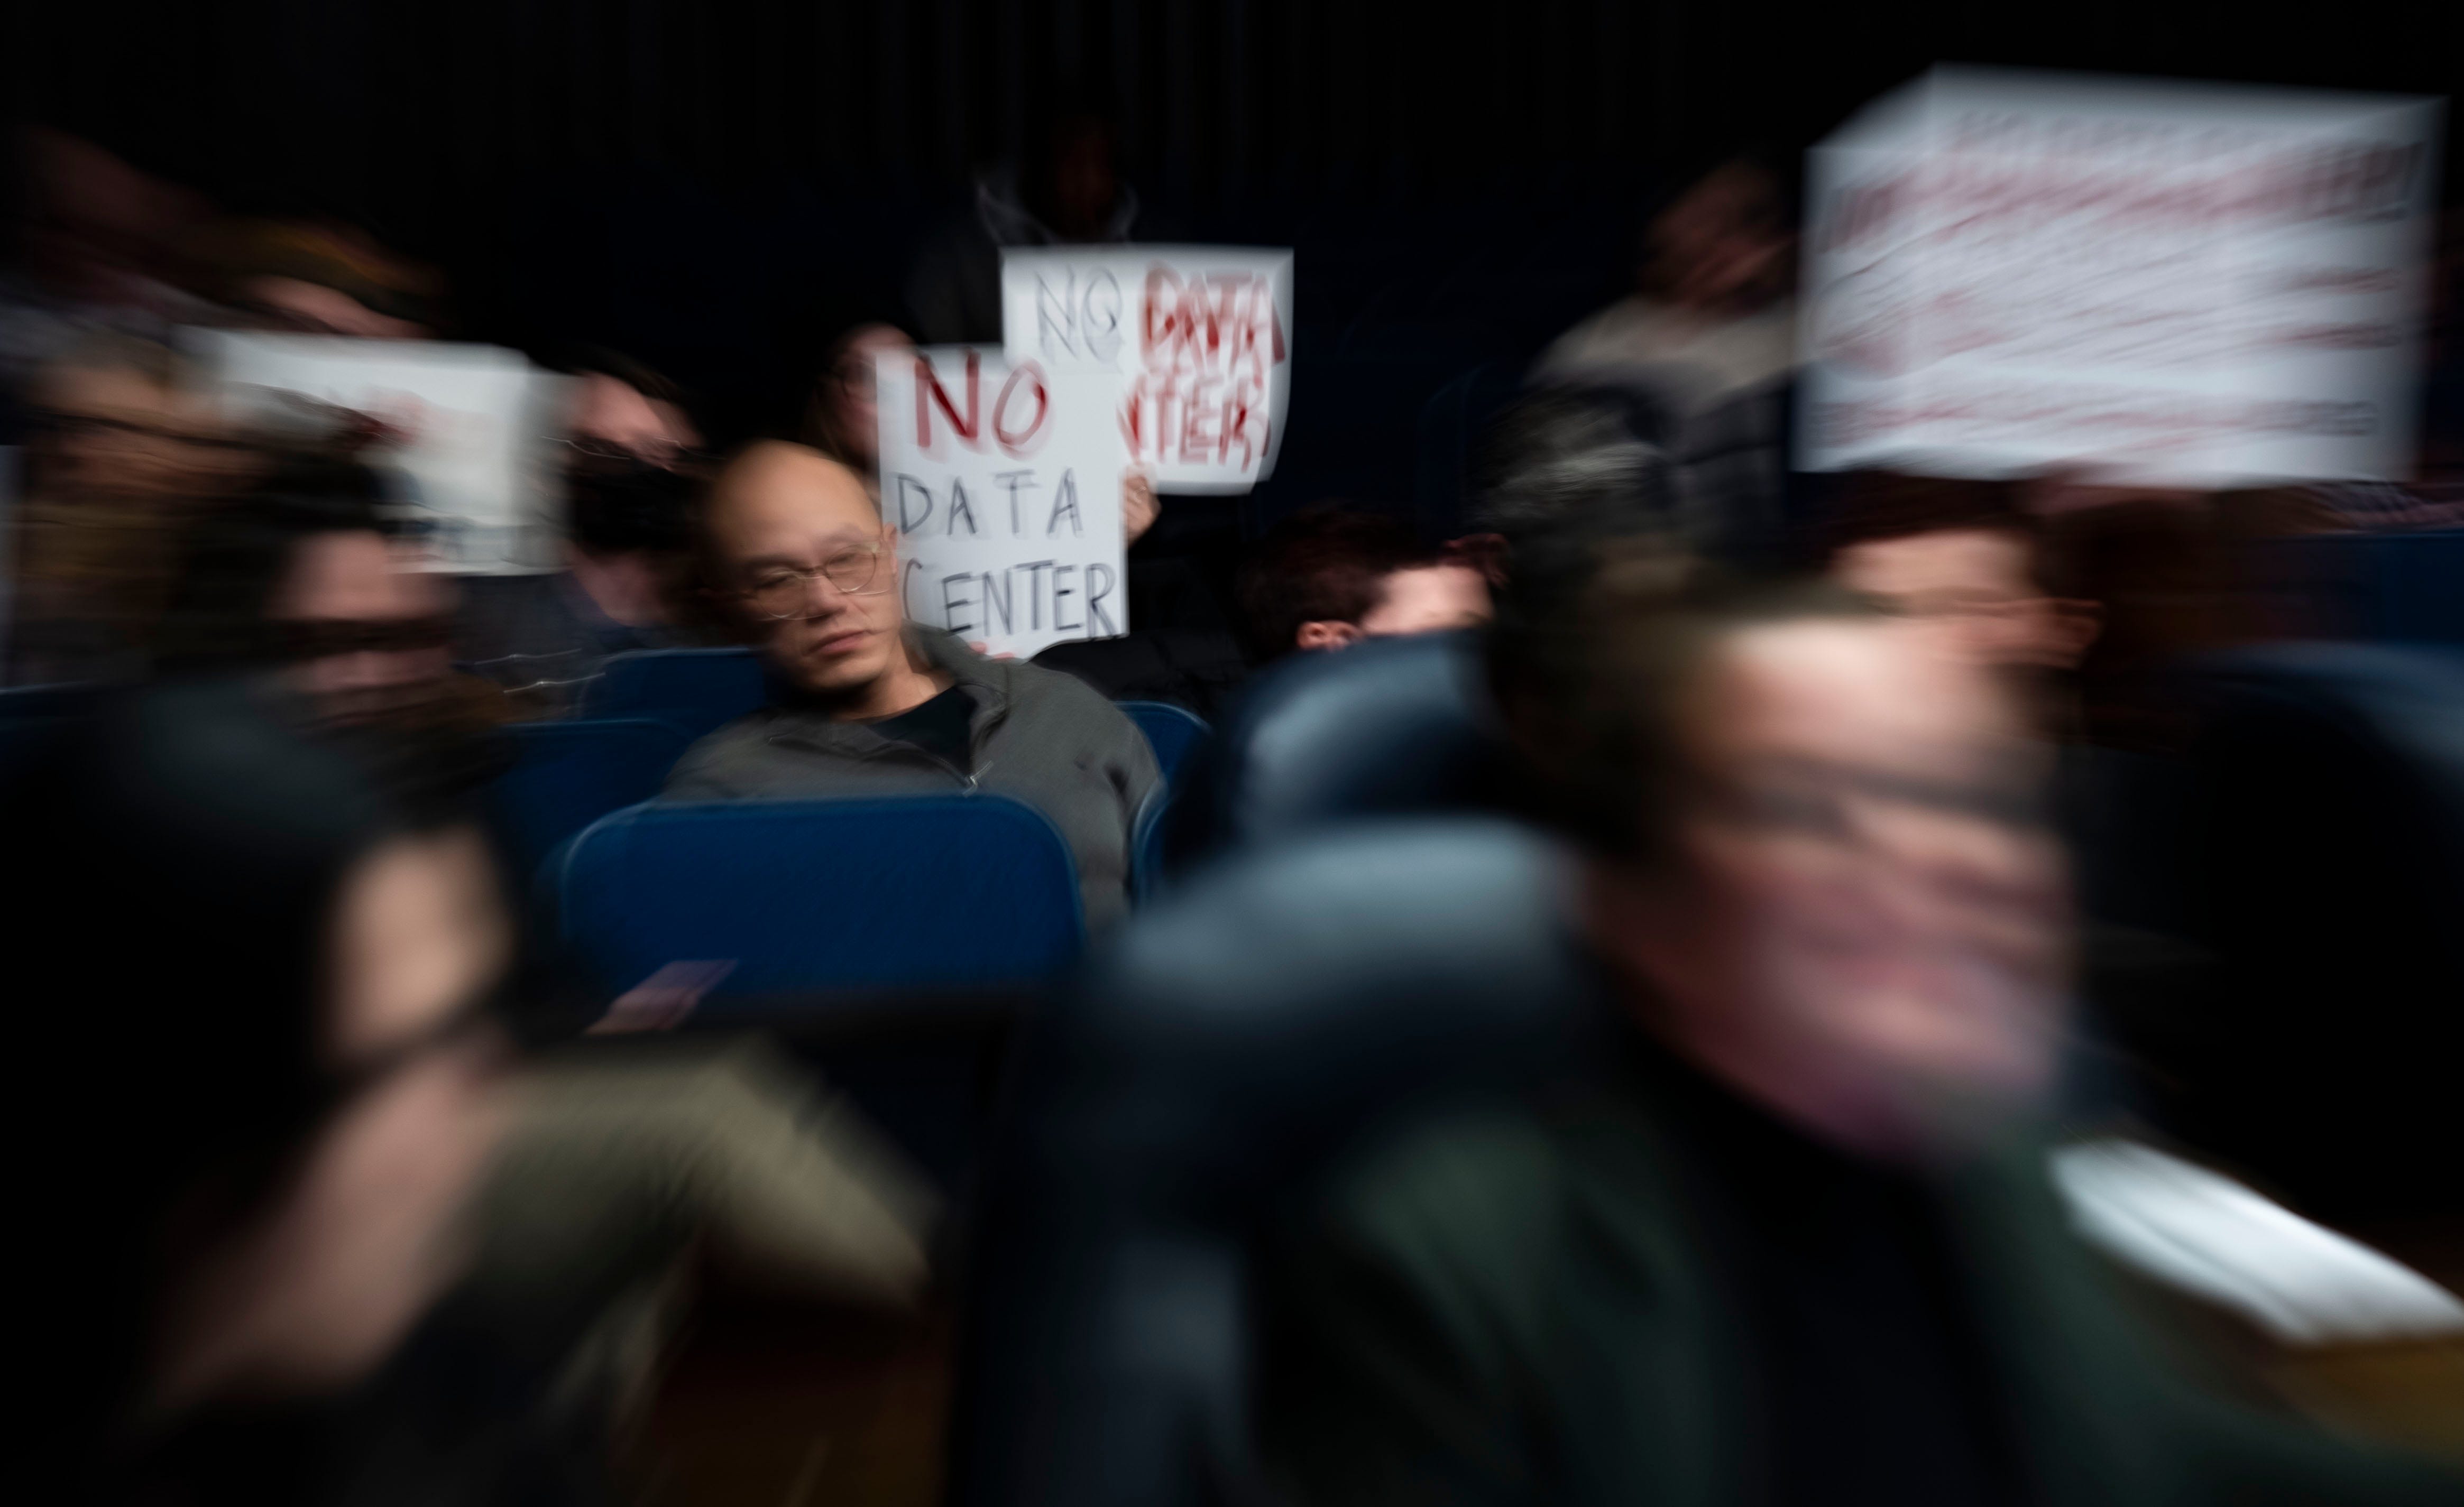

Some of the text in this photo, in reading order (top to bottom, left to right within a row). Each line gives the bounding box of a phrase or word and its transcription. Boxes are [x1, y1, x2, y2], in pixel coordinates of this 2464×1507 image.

[1034, 260, 1285, 385] NO DATA
[915, 349, 1050, 457] NO
[1116, 374, 1270, 472] NTER
[894, 468, 1083, 536] DATA
[902, 558, 1118, 638] CENTER
